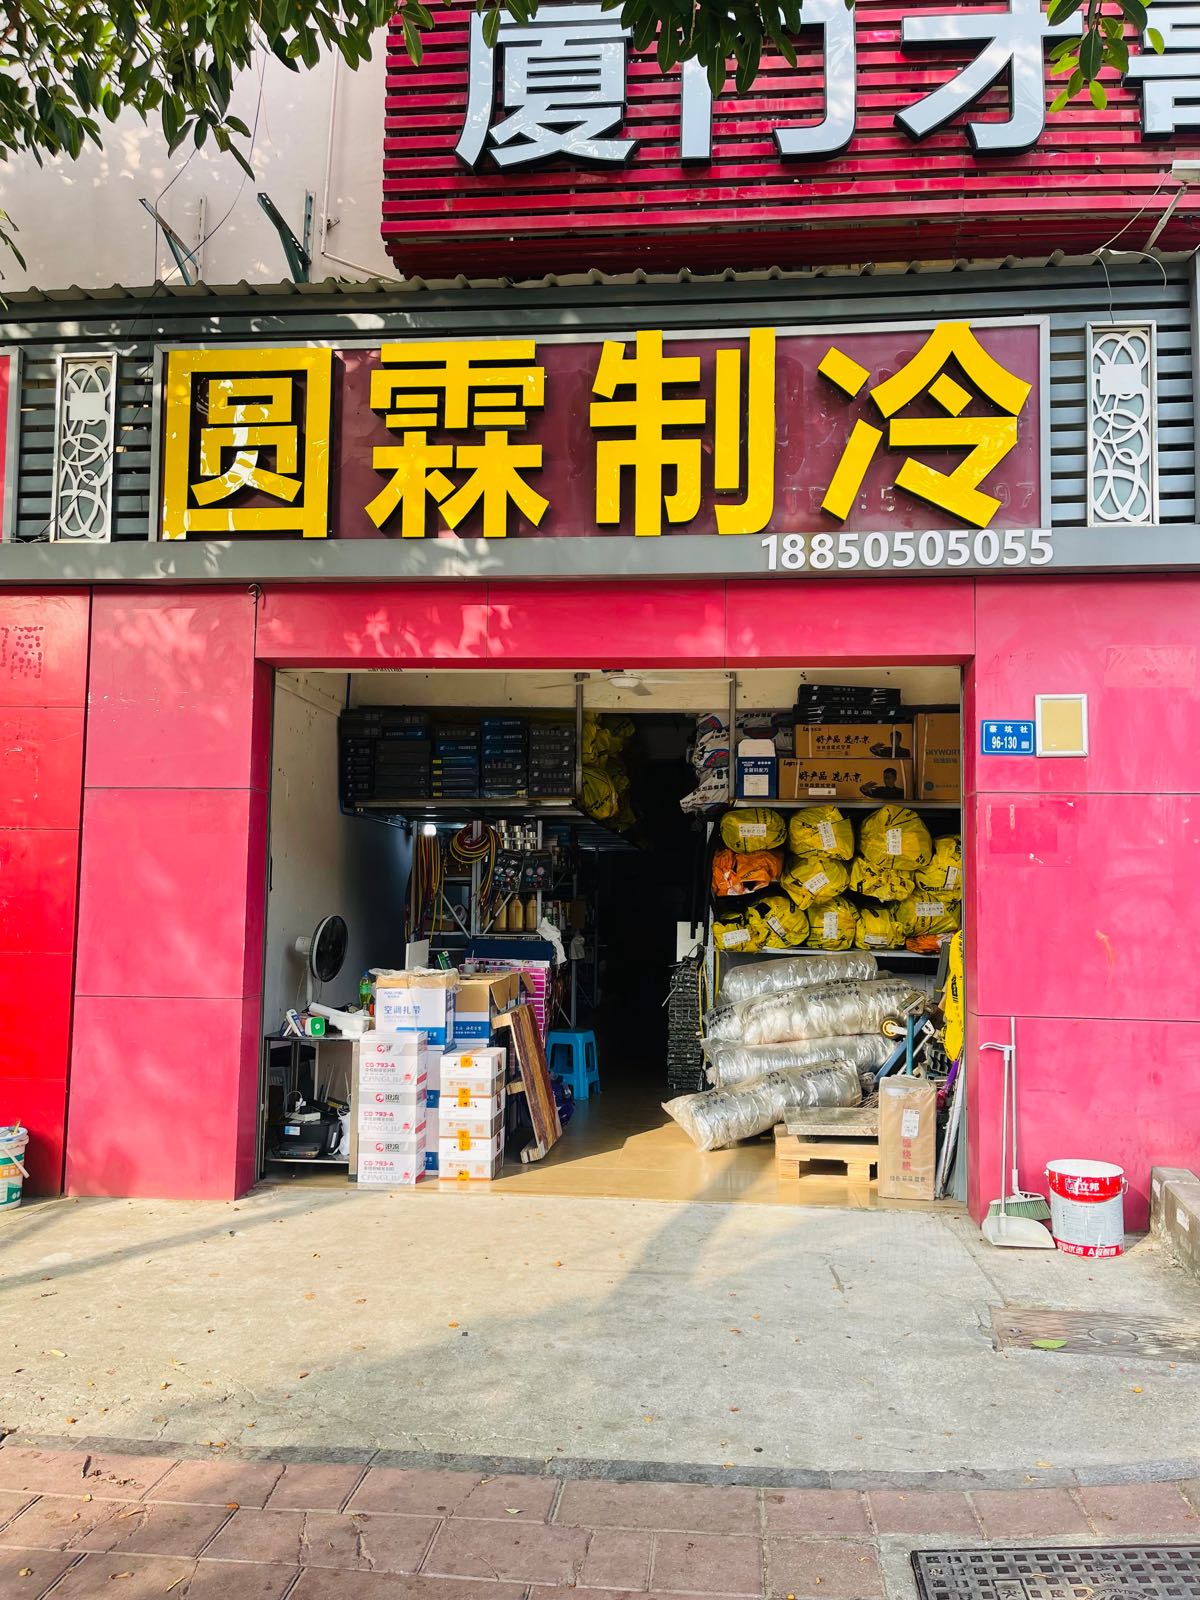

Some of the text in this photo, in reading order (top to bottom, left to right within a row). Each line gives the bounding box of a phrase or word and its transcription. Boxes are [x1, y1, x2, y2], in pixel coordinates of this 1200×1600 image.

[162, 321, 1033, 540] 圆霖制冷
[760, 528, 1055, 571] 18850505055
[991, 736, 1018, 749] 96-130
[1079, 1181, 1100, 1192] 立邦
